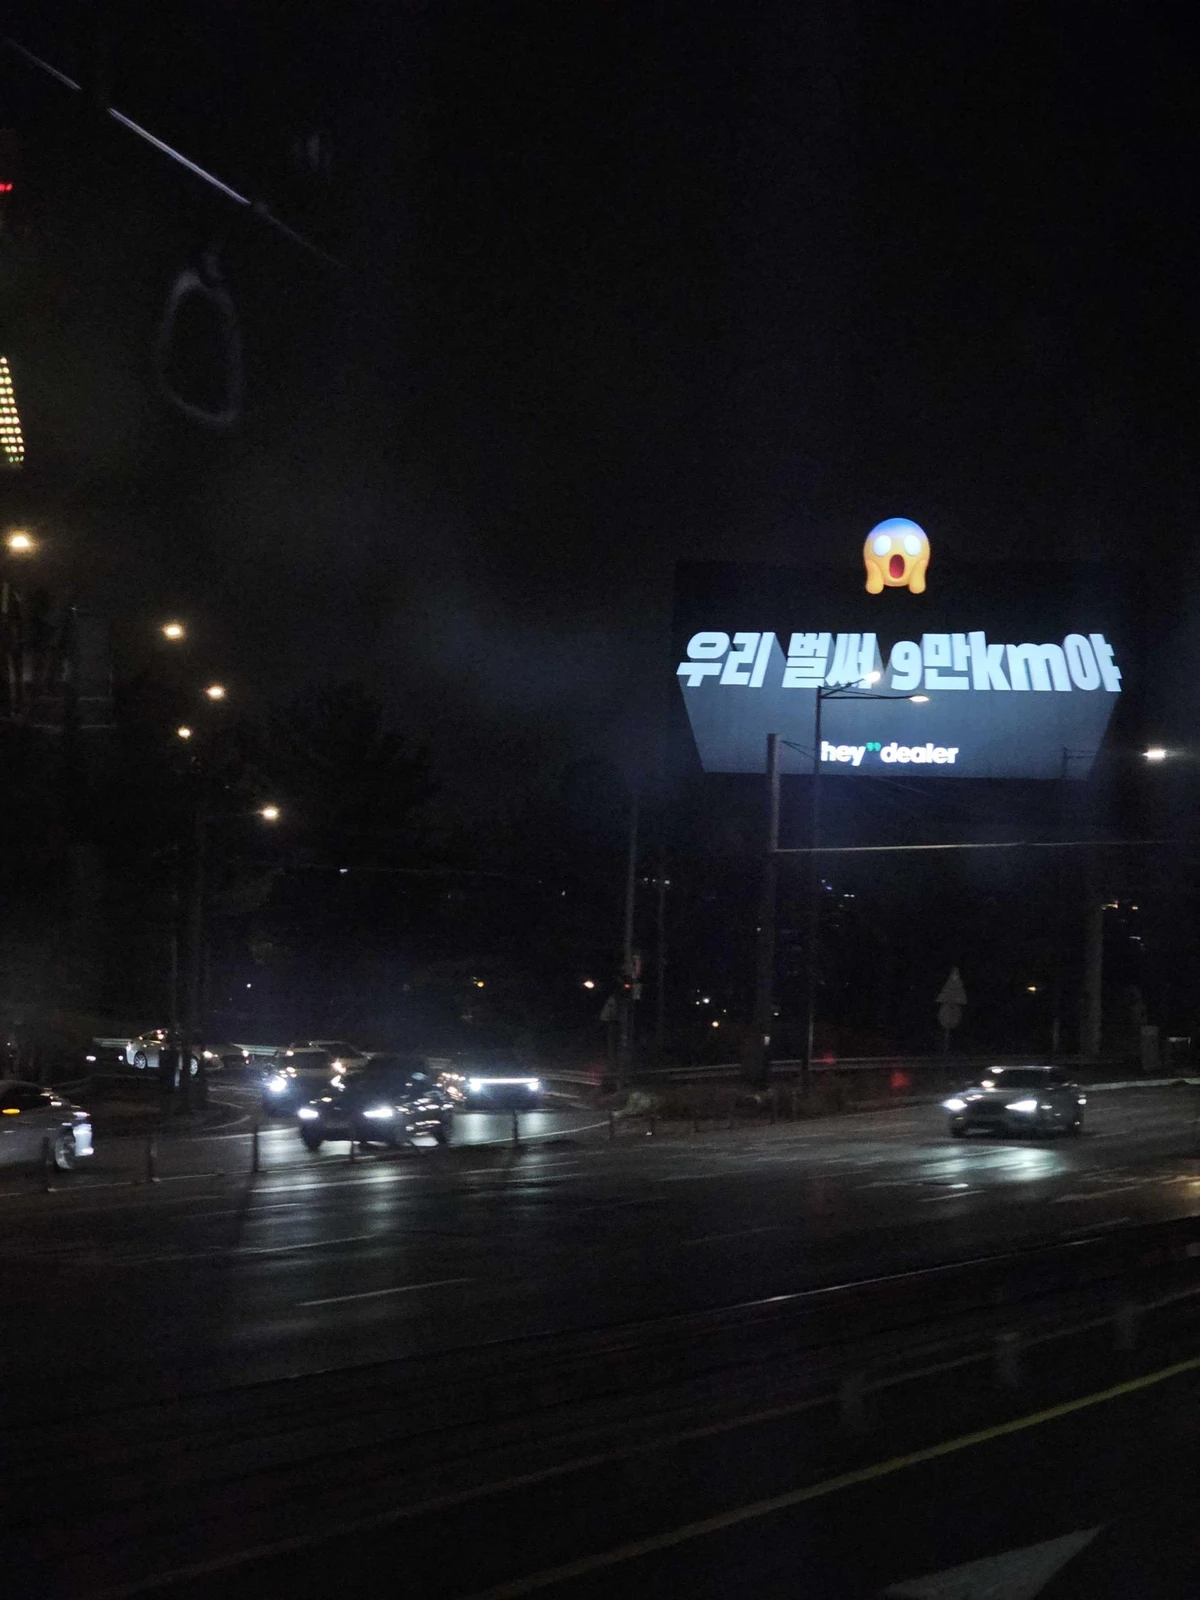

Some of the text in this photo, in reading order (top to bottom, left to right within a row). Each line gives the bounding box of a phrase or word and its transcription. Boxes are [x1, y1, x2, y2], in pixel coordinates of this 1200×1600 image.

[676, 631, 1123, 692] 우리 벌써 9만km야
[880, 742, 959, 764] dealer
